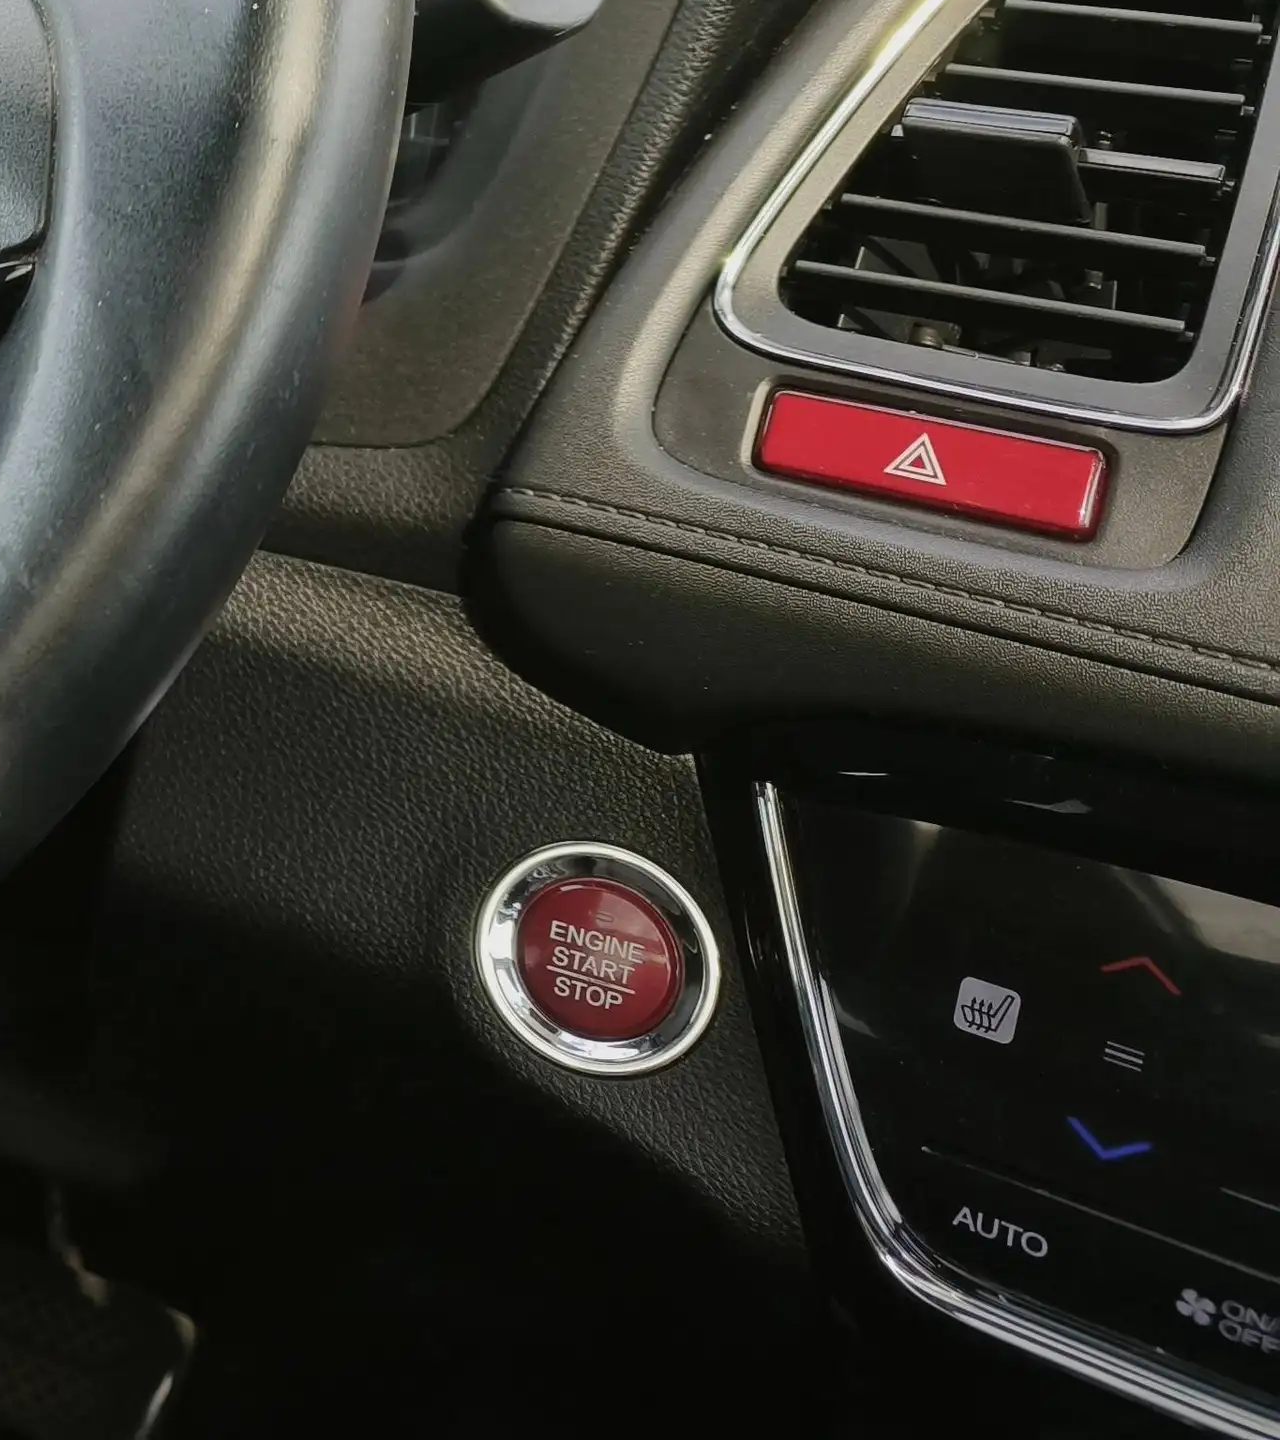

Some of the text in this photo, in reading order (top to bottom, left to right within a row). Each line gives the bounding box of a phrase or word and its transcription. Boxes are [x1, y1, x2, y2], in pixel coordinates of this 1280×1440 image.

[549, 920, 646, 964] ENGINE
[551, 945, 636, 985] START
[553, 976, 623, 1010] STOP
[952, 1206, 1049, 1258] AUTO
[1218, 1319, 1280, 1355] OFF
